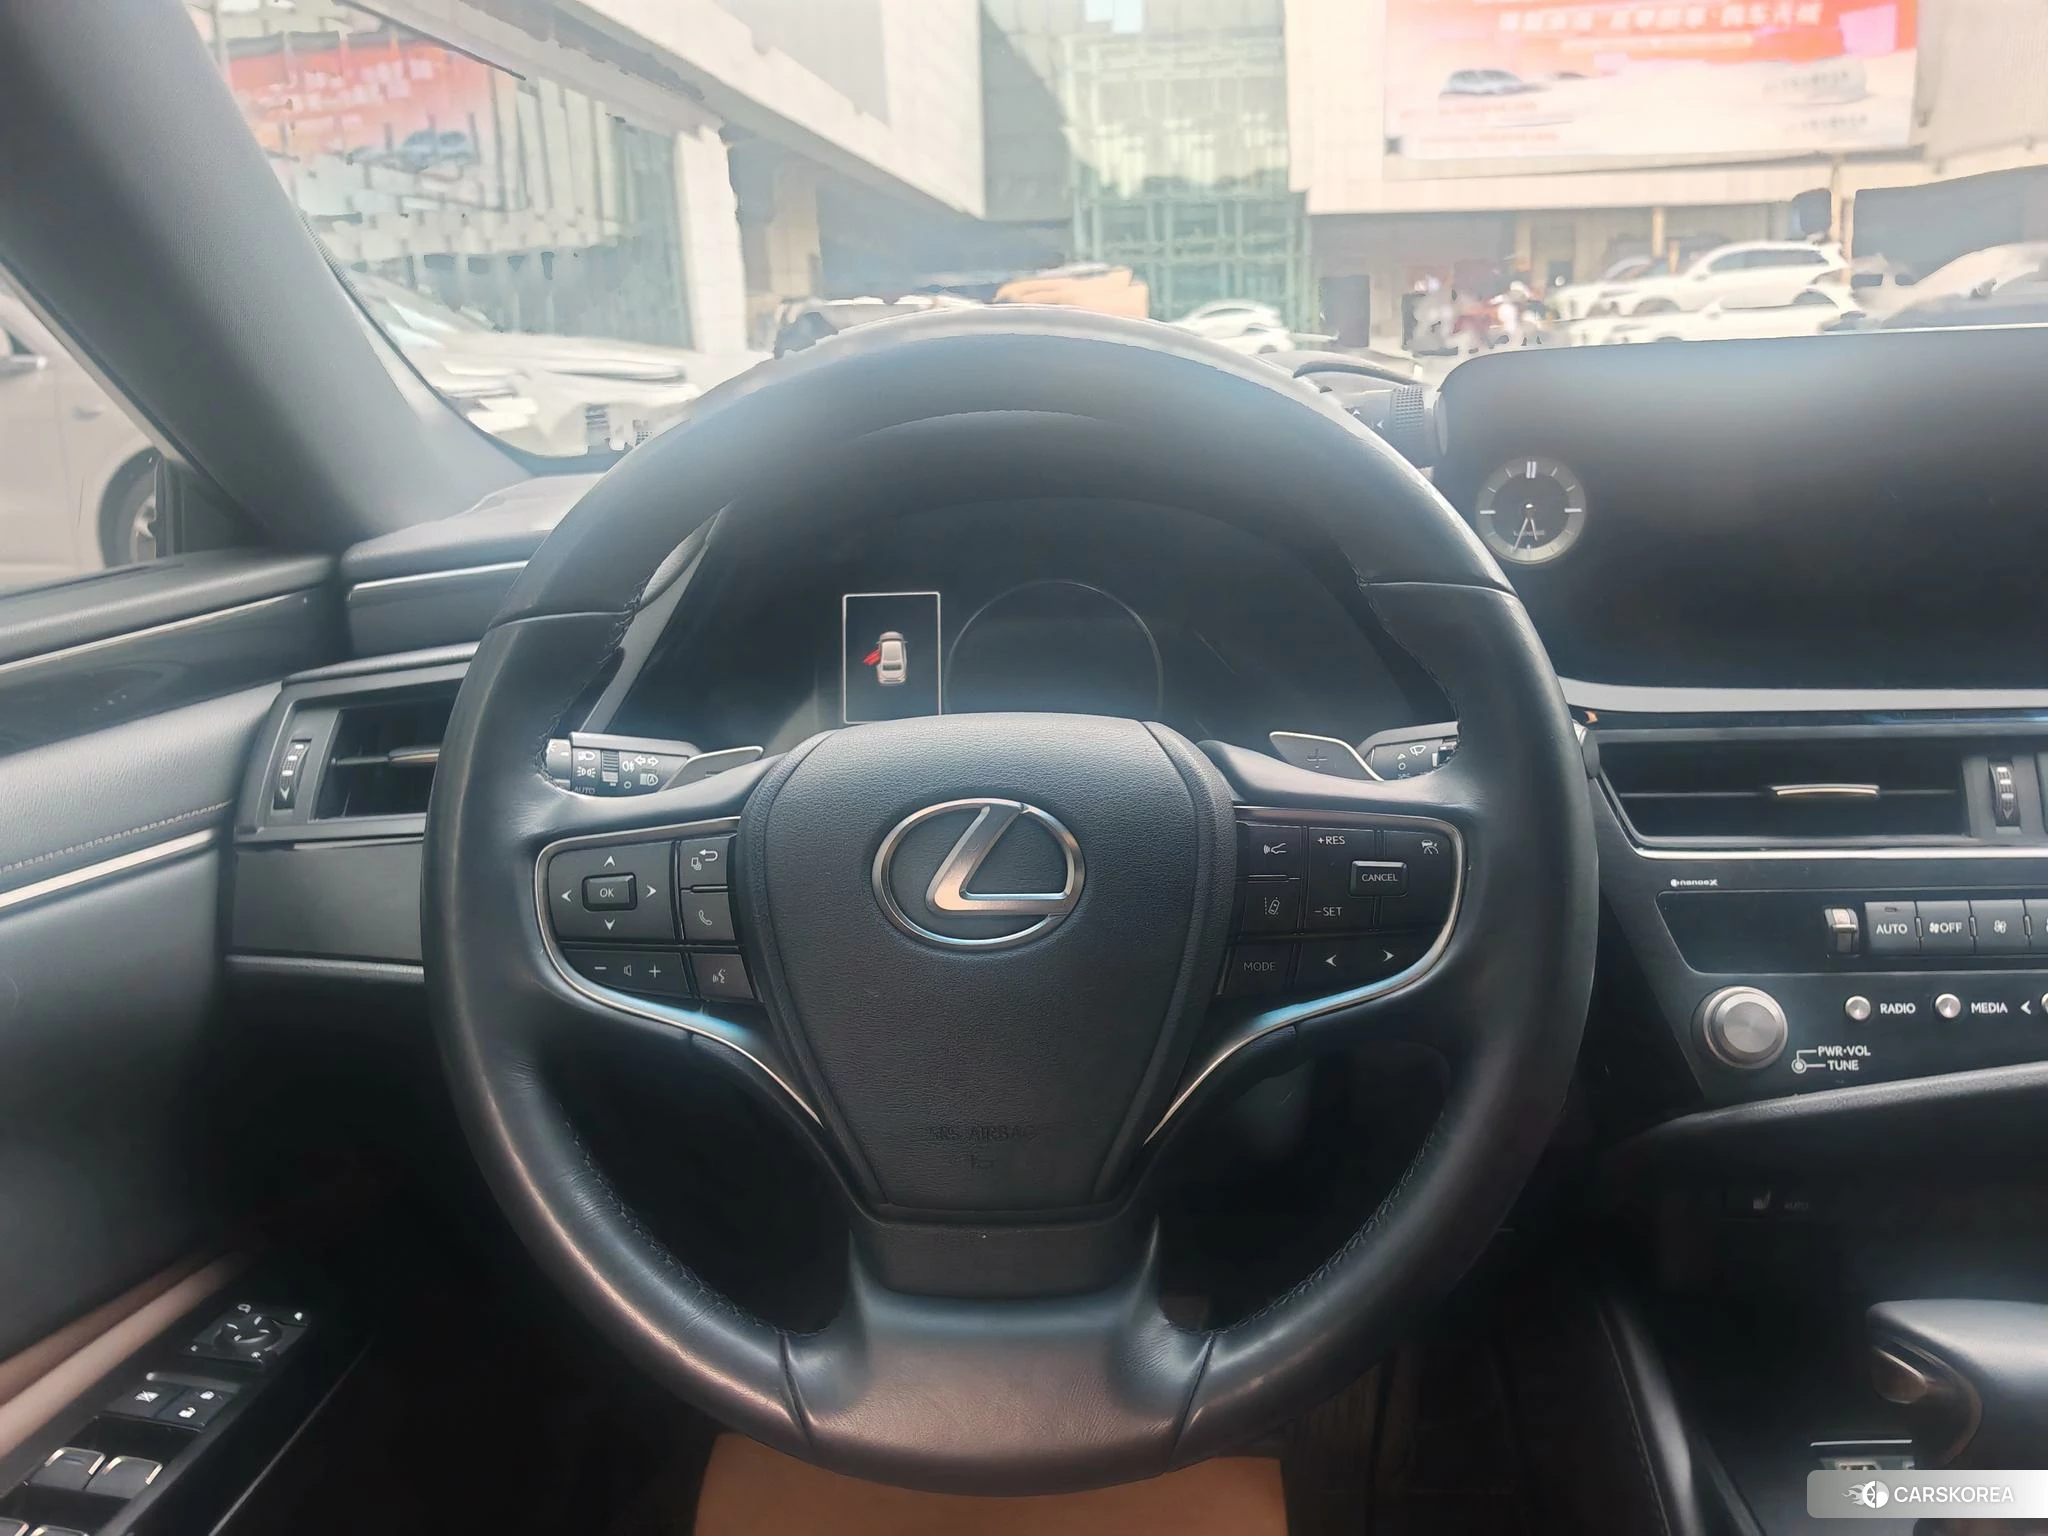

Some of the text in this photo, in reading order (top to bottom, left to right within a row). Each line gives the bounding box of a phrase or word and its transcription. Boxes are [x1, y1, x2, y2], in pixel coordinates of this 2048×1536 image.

[1317, 835, 1346, 846] +RES
[1361, 873, 1399, 883] CANCEL
[599, 887, 615, 899] OK
[1876, 922, 1908, 935] AUTO
[1940, 922, 1963, 934] OFF
[1243, 961, 1276, 972] MODE
[1880, 1002, 1916, 1015] RADIO
[1971, 1002, 2008, 1015] MEDIA
[1827, 1060, 1859, 1071] TUNE
